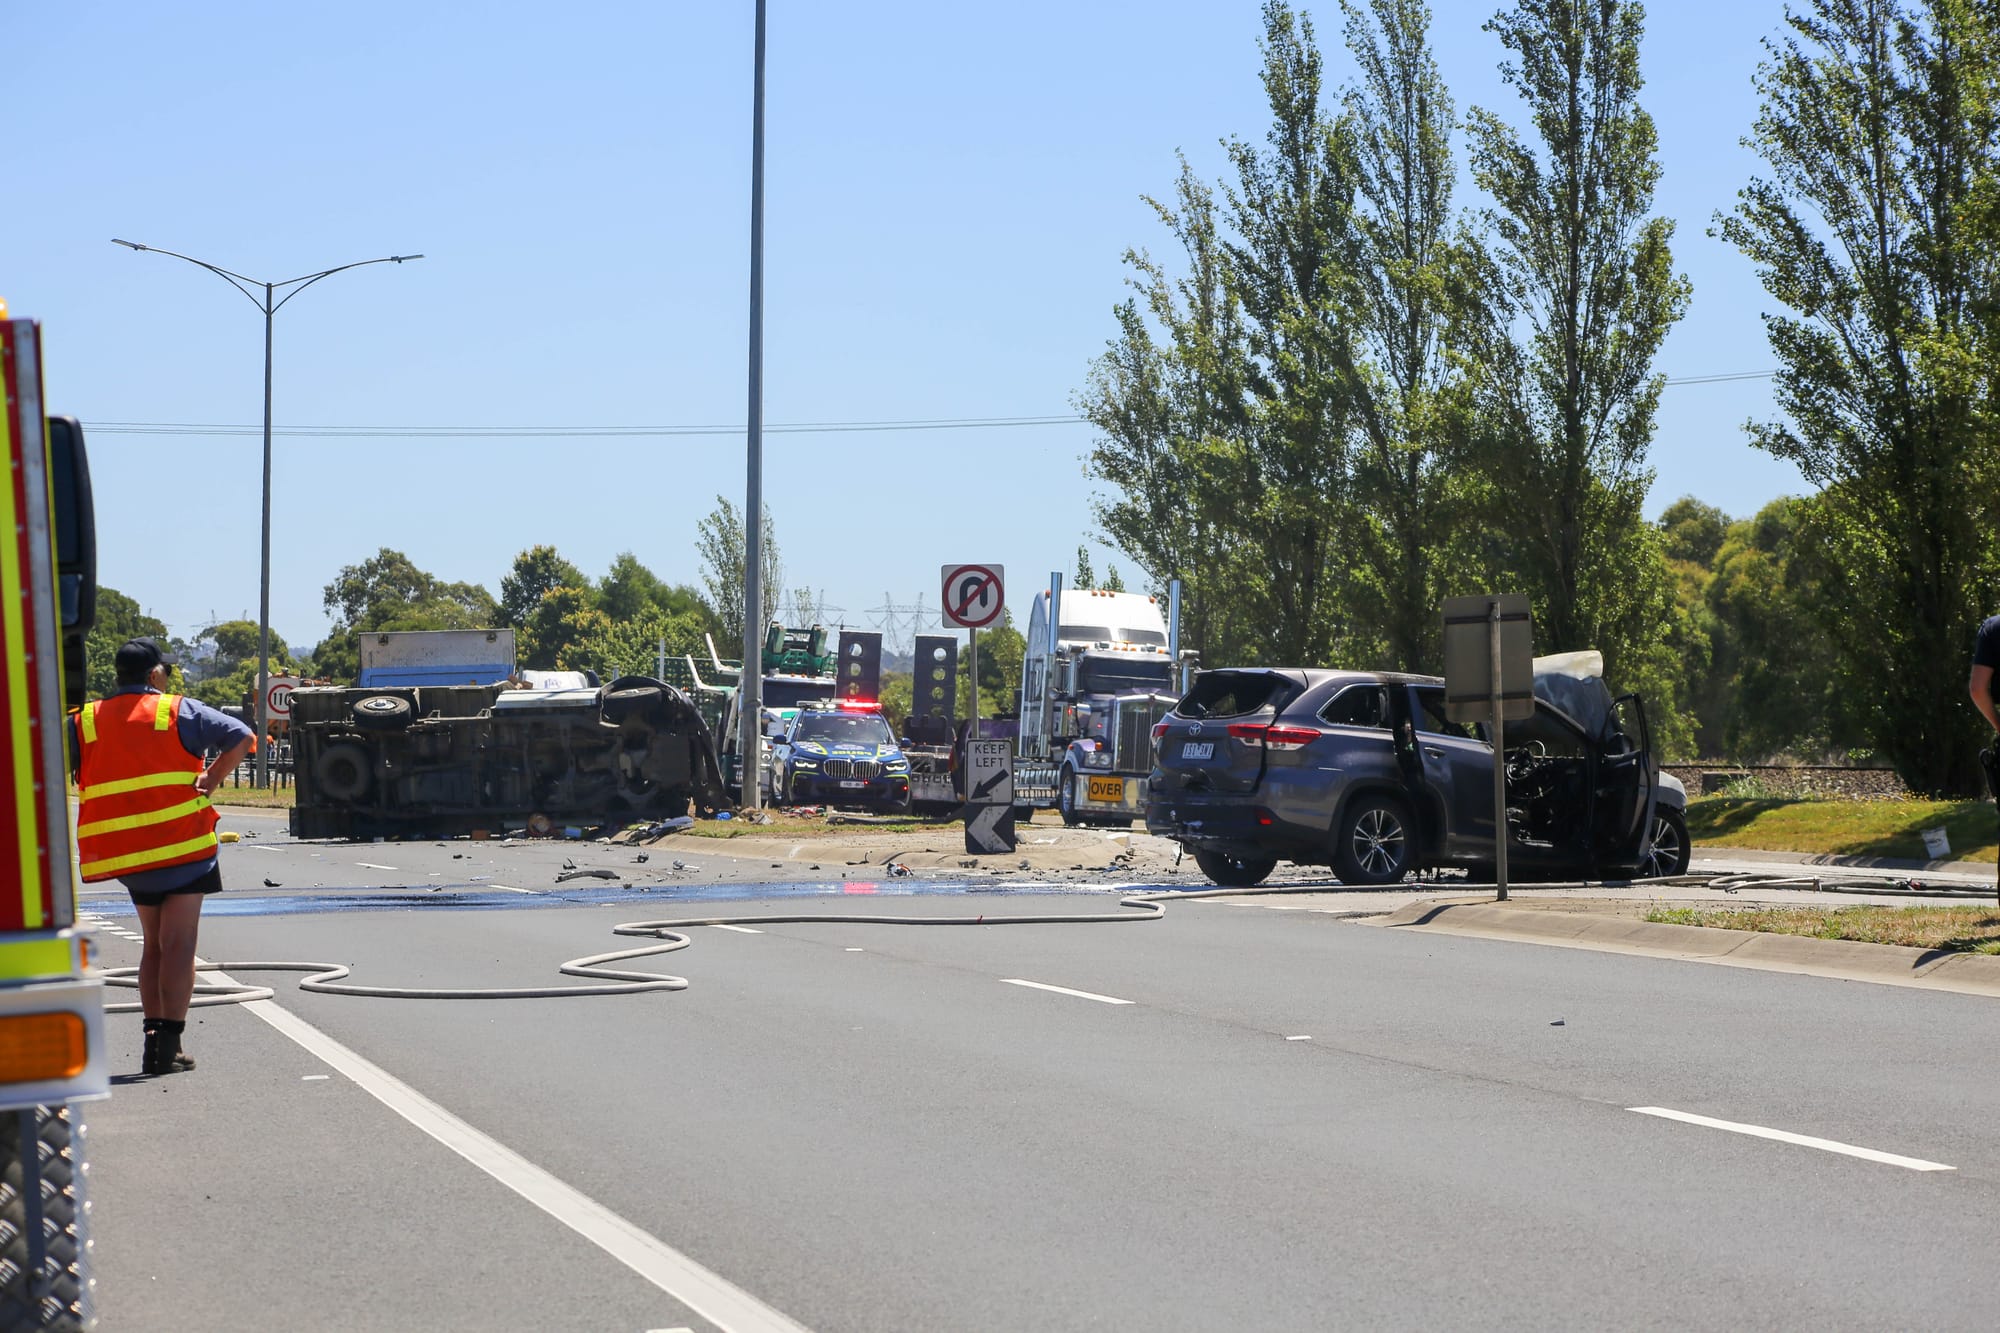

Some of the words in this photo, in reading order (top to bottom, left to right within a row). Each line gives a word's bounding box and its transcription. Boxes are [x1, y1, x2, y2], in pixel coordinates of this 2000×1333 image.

[974, 743, 1006, 755] KEEP
[975, 757, 1004, 768] LEFT
[1091, 782, 1122, 796] OVER
